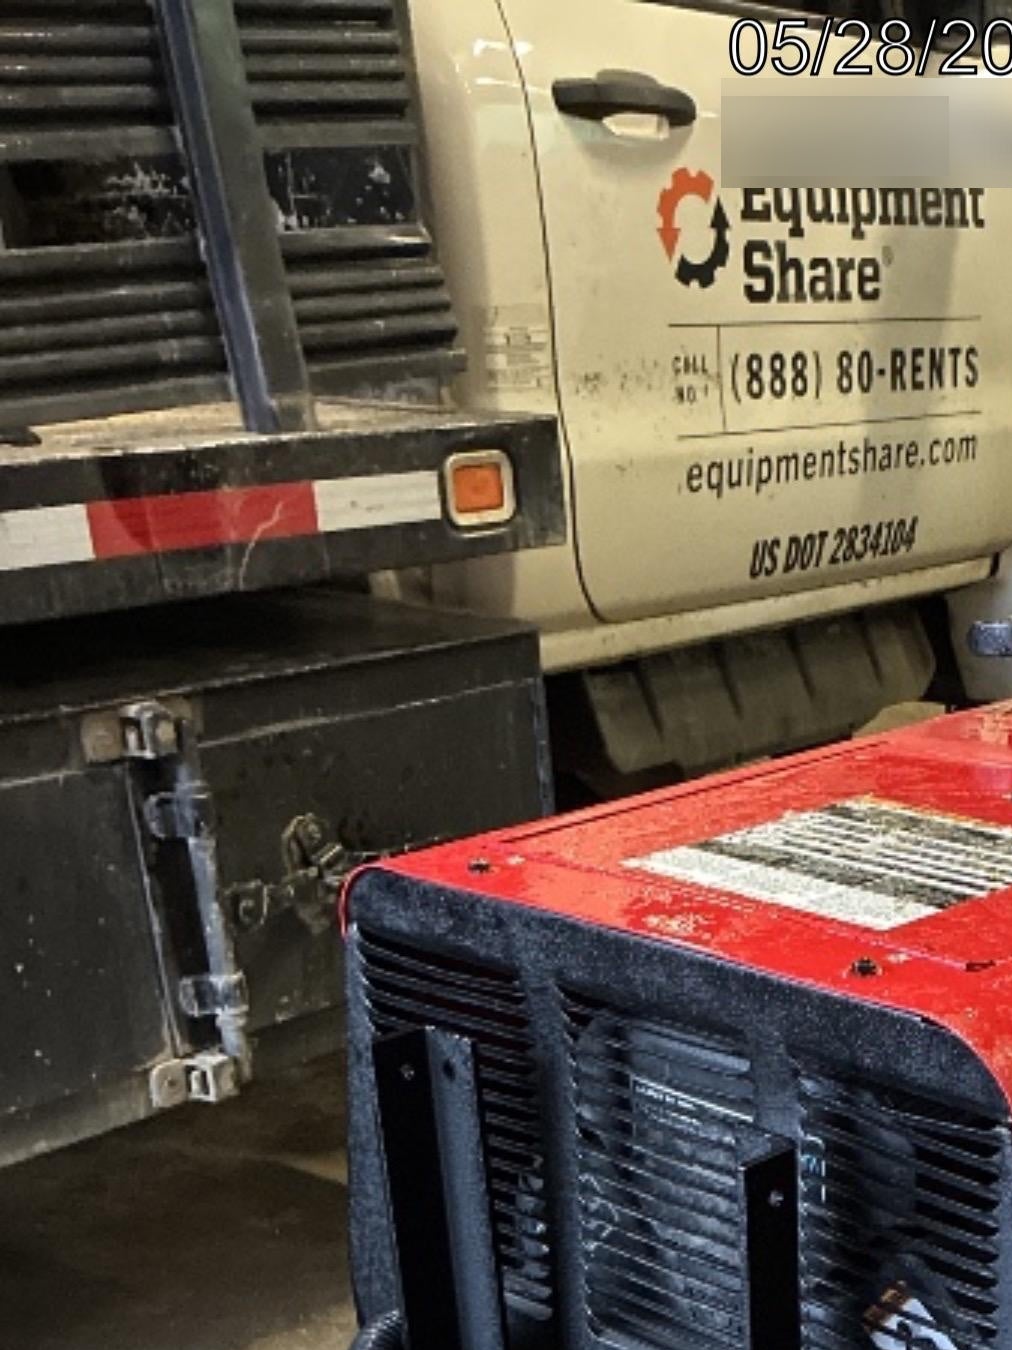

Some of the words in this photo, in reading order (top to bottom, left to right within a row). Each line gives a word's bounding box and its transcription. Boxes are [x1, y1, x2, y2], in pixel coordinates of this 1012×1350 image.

[743, 239, 881, 303] Share
[731, 351, 822, 404] (888)
[836, 346, 979, 394] 80-RENTS
[686, 433, 977, 498] equipmentshare.com
[750, 538, 780, 579] US
[782, 530, 829, 573] DOT
[828, 515, 919, 565] 2834104
